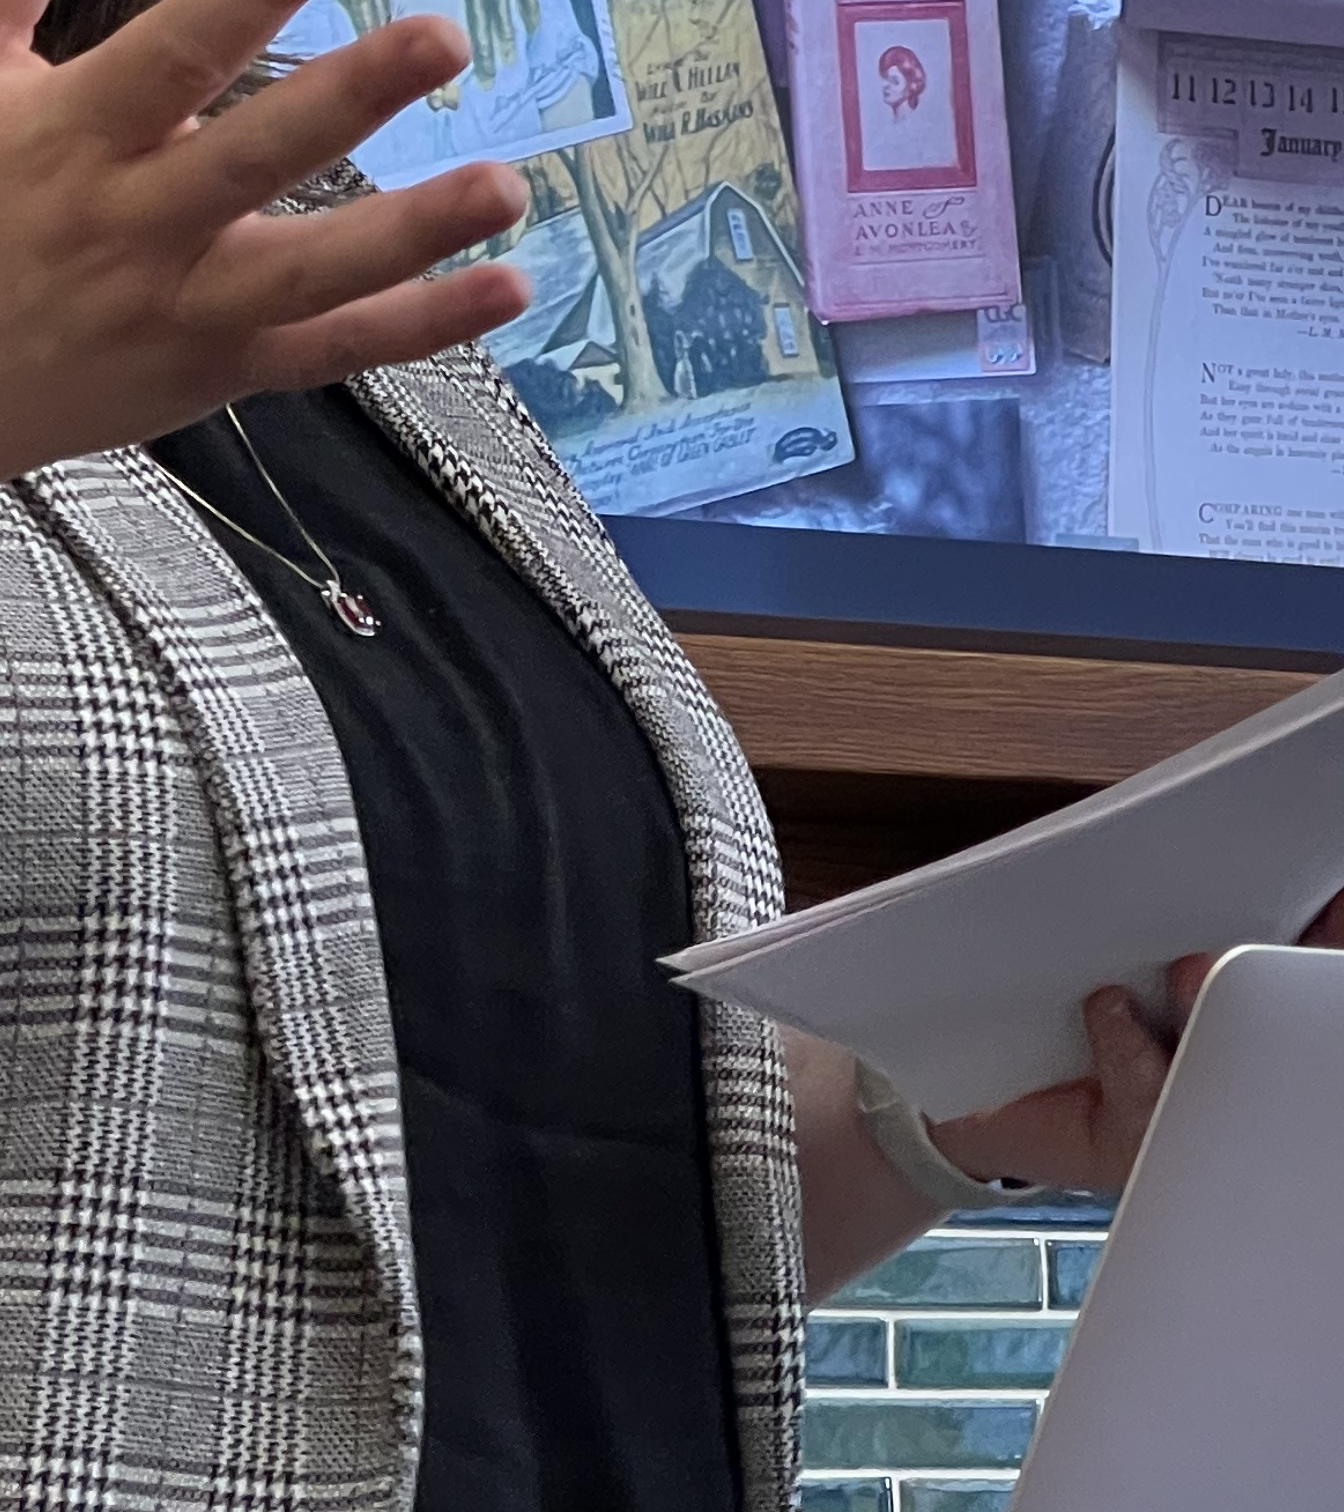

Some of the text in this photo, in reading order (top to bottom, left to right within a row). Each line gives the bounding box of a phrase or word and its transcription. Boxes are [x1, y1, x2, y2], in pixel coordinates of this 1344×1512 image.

[1212, 78, 1236, 104] 12
[1250, 80, 1275, 108] 13
[1288, 85, 1313, 113] 14
[1260, 128, 1342, 162] January
[853, 200, 913, 218] ANNE
[855, 221, 957, 241] AVONLEA
